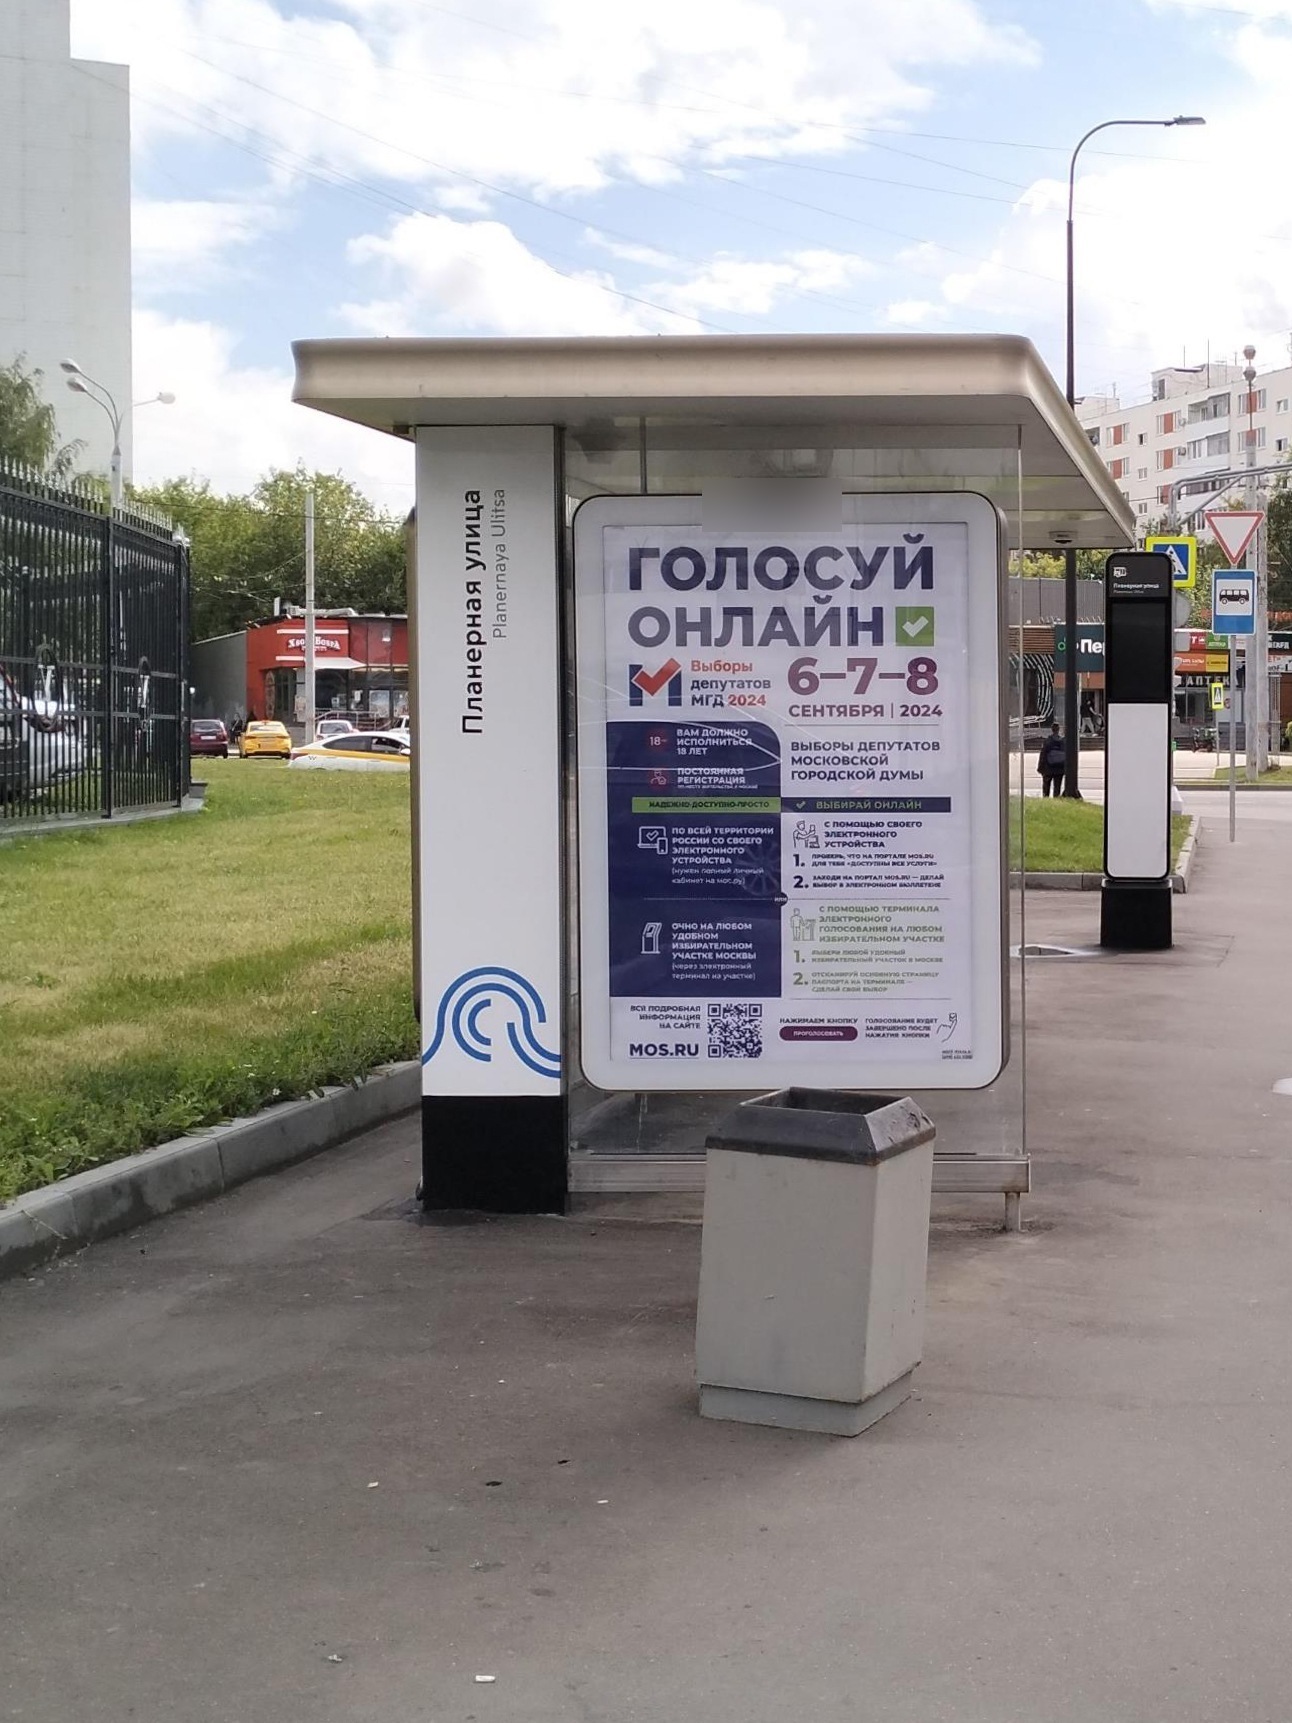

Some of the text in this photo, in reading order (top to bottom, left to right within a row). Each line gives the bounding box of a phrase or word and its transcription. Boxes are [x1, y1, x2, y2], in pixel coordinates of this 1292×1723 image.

[491, 489, 509, 638] Planernaya Ulitsa
[629, 533, 934, 591] ГОЛОСУЙ
[461, 489, 487, 734] Планерная улица
[628, 594, 884, 647] ОНЛАЙН
[691, 660, 753, 673] Выборы
[1187, 675, 1230, 686] АПТЕК
[691, 680, 771, 694] депутатов
[691, 695, 766, 708] МГД 2024
[788, 704, 943, 718] СЕНТЯБРЯ 2024
[676, 729, 749, 738] ВАМ ДОЛЖНО
[676, 738, 752, 746] ИСПОЛНИТЬСЯ
[791, 742, 941, 752] ВЫБОРЫ ДЕПУТАТОВ
[791, 753, 889, 766] МОСКОВСКОЙ
[791, 768, 924, 781] ГОРОДСКОЙ ДУМЫ
[677, 776, 746, 785] РЕГИСТРАЦИЯ
[816, 800, 922, 809] ВЫБИРАЙ ОНЛАЙН
[832, 821, 884, 829] ПОМОЩЬЮ
[688, 826, 711, 834] ВСЕЙ
[714, 827, 774, 835] ТЕРРИТОРИИ
[824, 840, 885, 848] УСТРОЙСТВА
[672, 856, 732, 864] УСТРОЙСТВА
[793, 854, 805, 867] 1.
[793, 875, 809, 889] 2.
[827, 906, 879, 914] ПОМОЩЬЮ
[671, 922, 752, 930] ОЧНО НА ЛЮБОМ
[671, 932, 719, 940] УДОБНОМ
[671, 952, 757, 960] УЧАСТКЕ МОСКВЫ
[673, 1021, 701, 1029] САЙТЕ
[629, 1043, 699, 1057] MOS.RU
